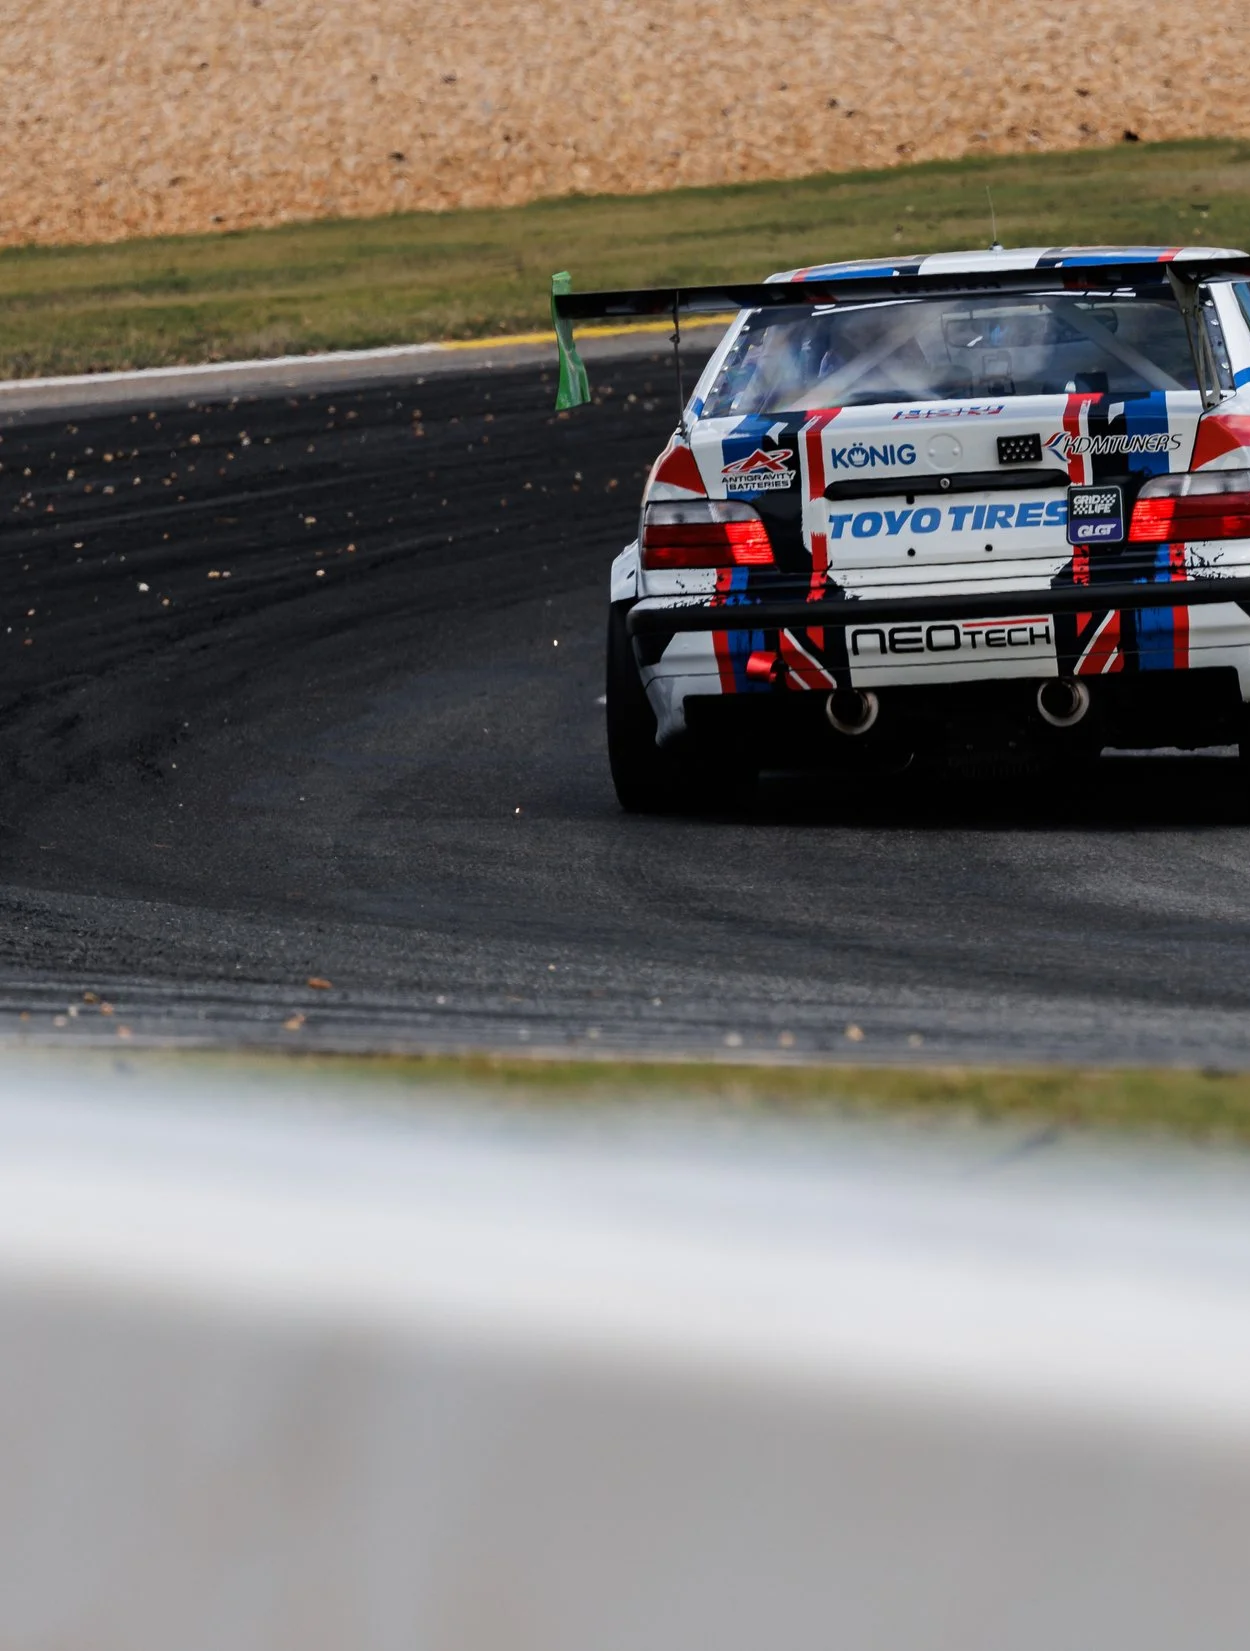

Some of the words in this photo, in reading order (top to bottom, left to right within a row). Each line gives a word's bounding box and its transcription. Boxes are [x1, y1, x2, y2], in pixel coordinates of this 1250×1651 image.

[1063, 432, 1183, 455] KDMTUNERS
[831, 442, 917, 470] KÖNIG
[721, 471, 795, 484] ANTIGRAVITY
[729, 480, 789, 491] BATTERIES
[1073, 494, 1101, 506] GRID
[1088, 503, 1112, 514] LIFE
[828, 506, 942, 540] TOYO
[948, 499, 1067, 532] TIRES
[1077, 523, 1117, 538] GLGT
